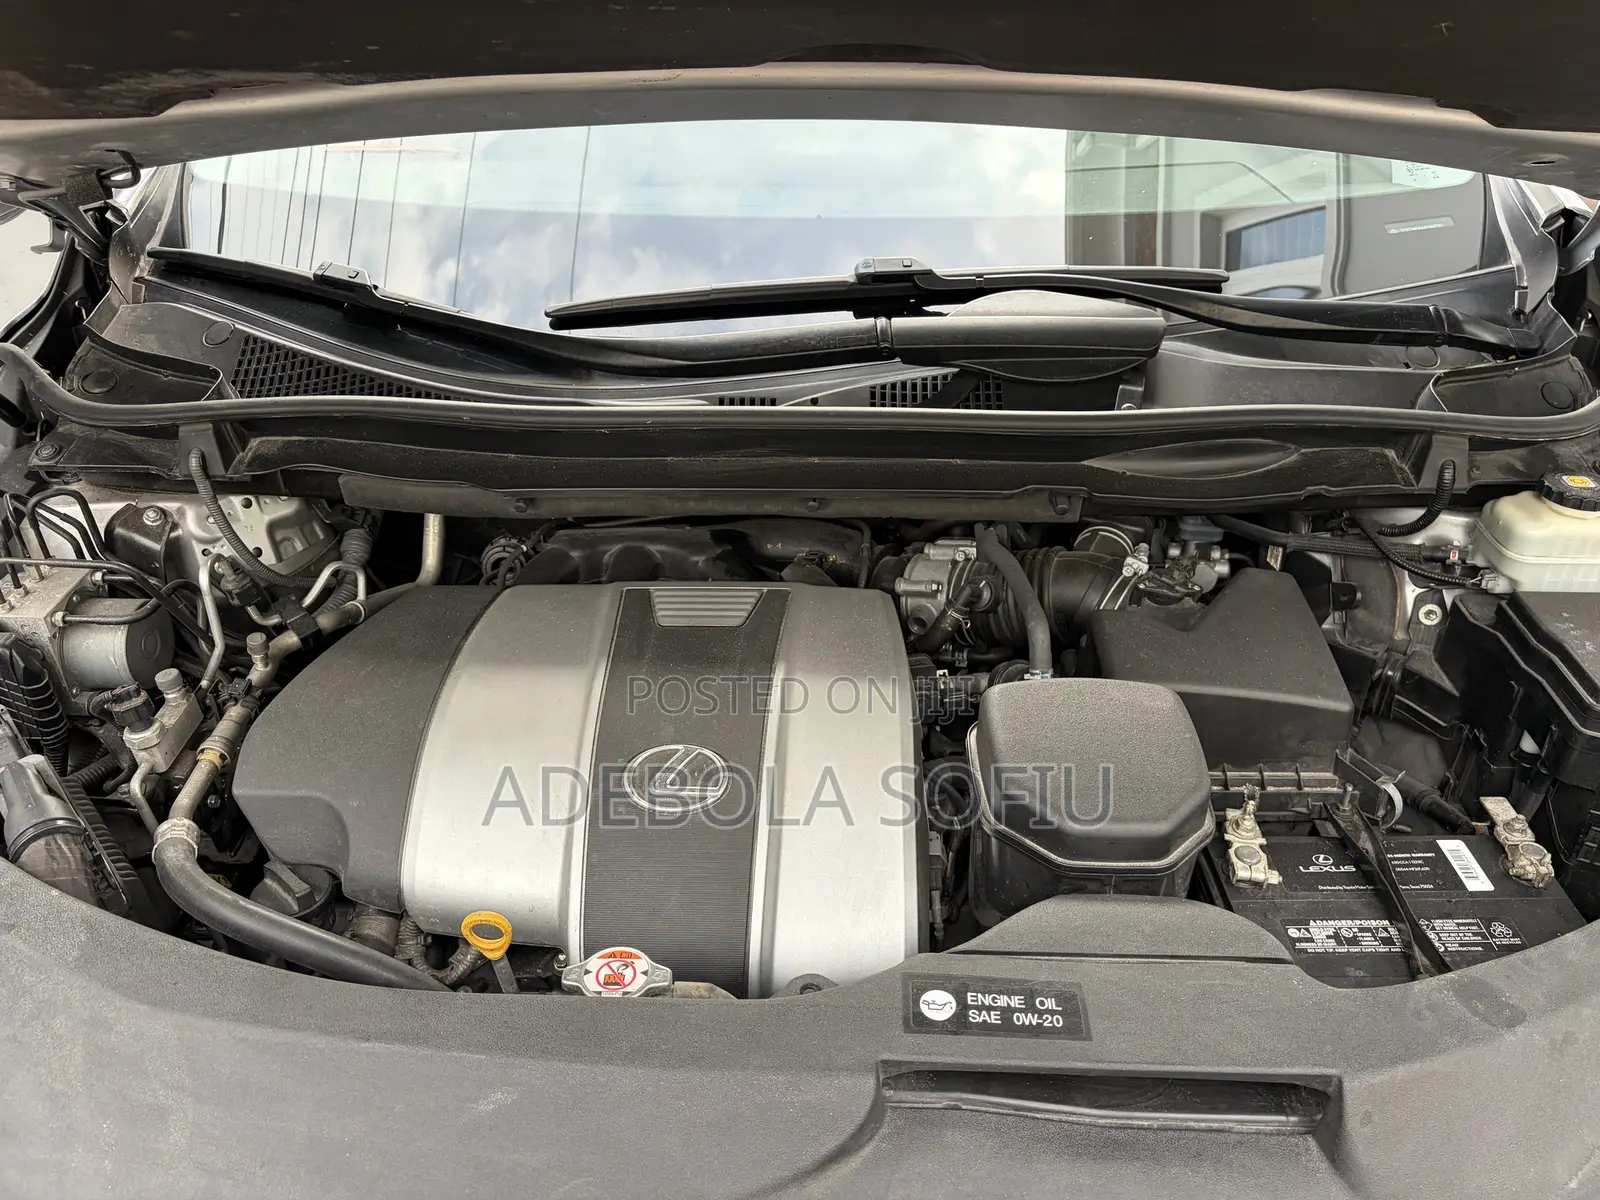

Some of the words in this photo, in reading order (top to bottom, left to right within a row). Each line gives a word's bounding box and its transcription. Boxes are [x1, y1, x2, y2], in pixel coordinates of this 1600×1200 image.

[1298, 865, 1357, 873] LEXUS
[966, 991, 1026, 1009] ENGINE
[1035, 997, 1063, 1011] OIL
[968, 1009, 1002, 1024] SAE
[1012, 1011, 1064, 1028] 0W-20
